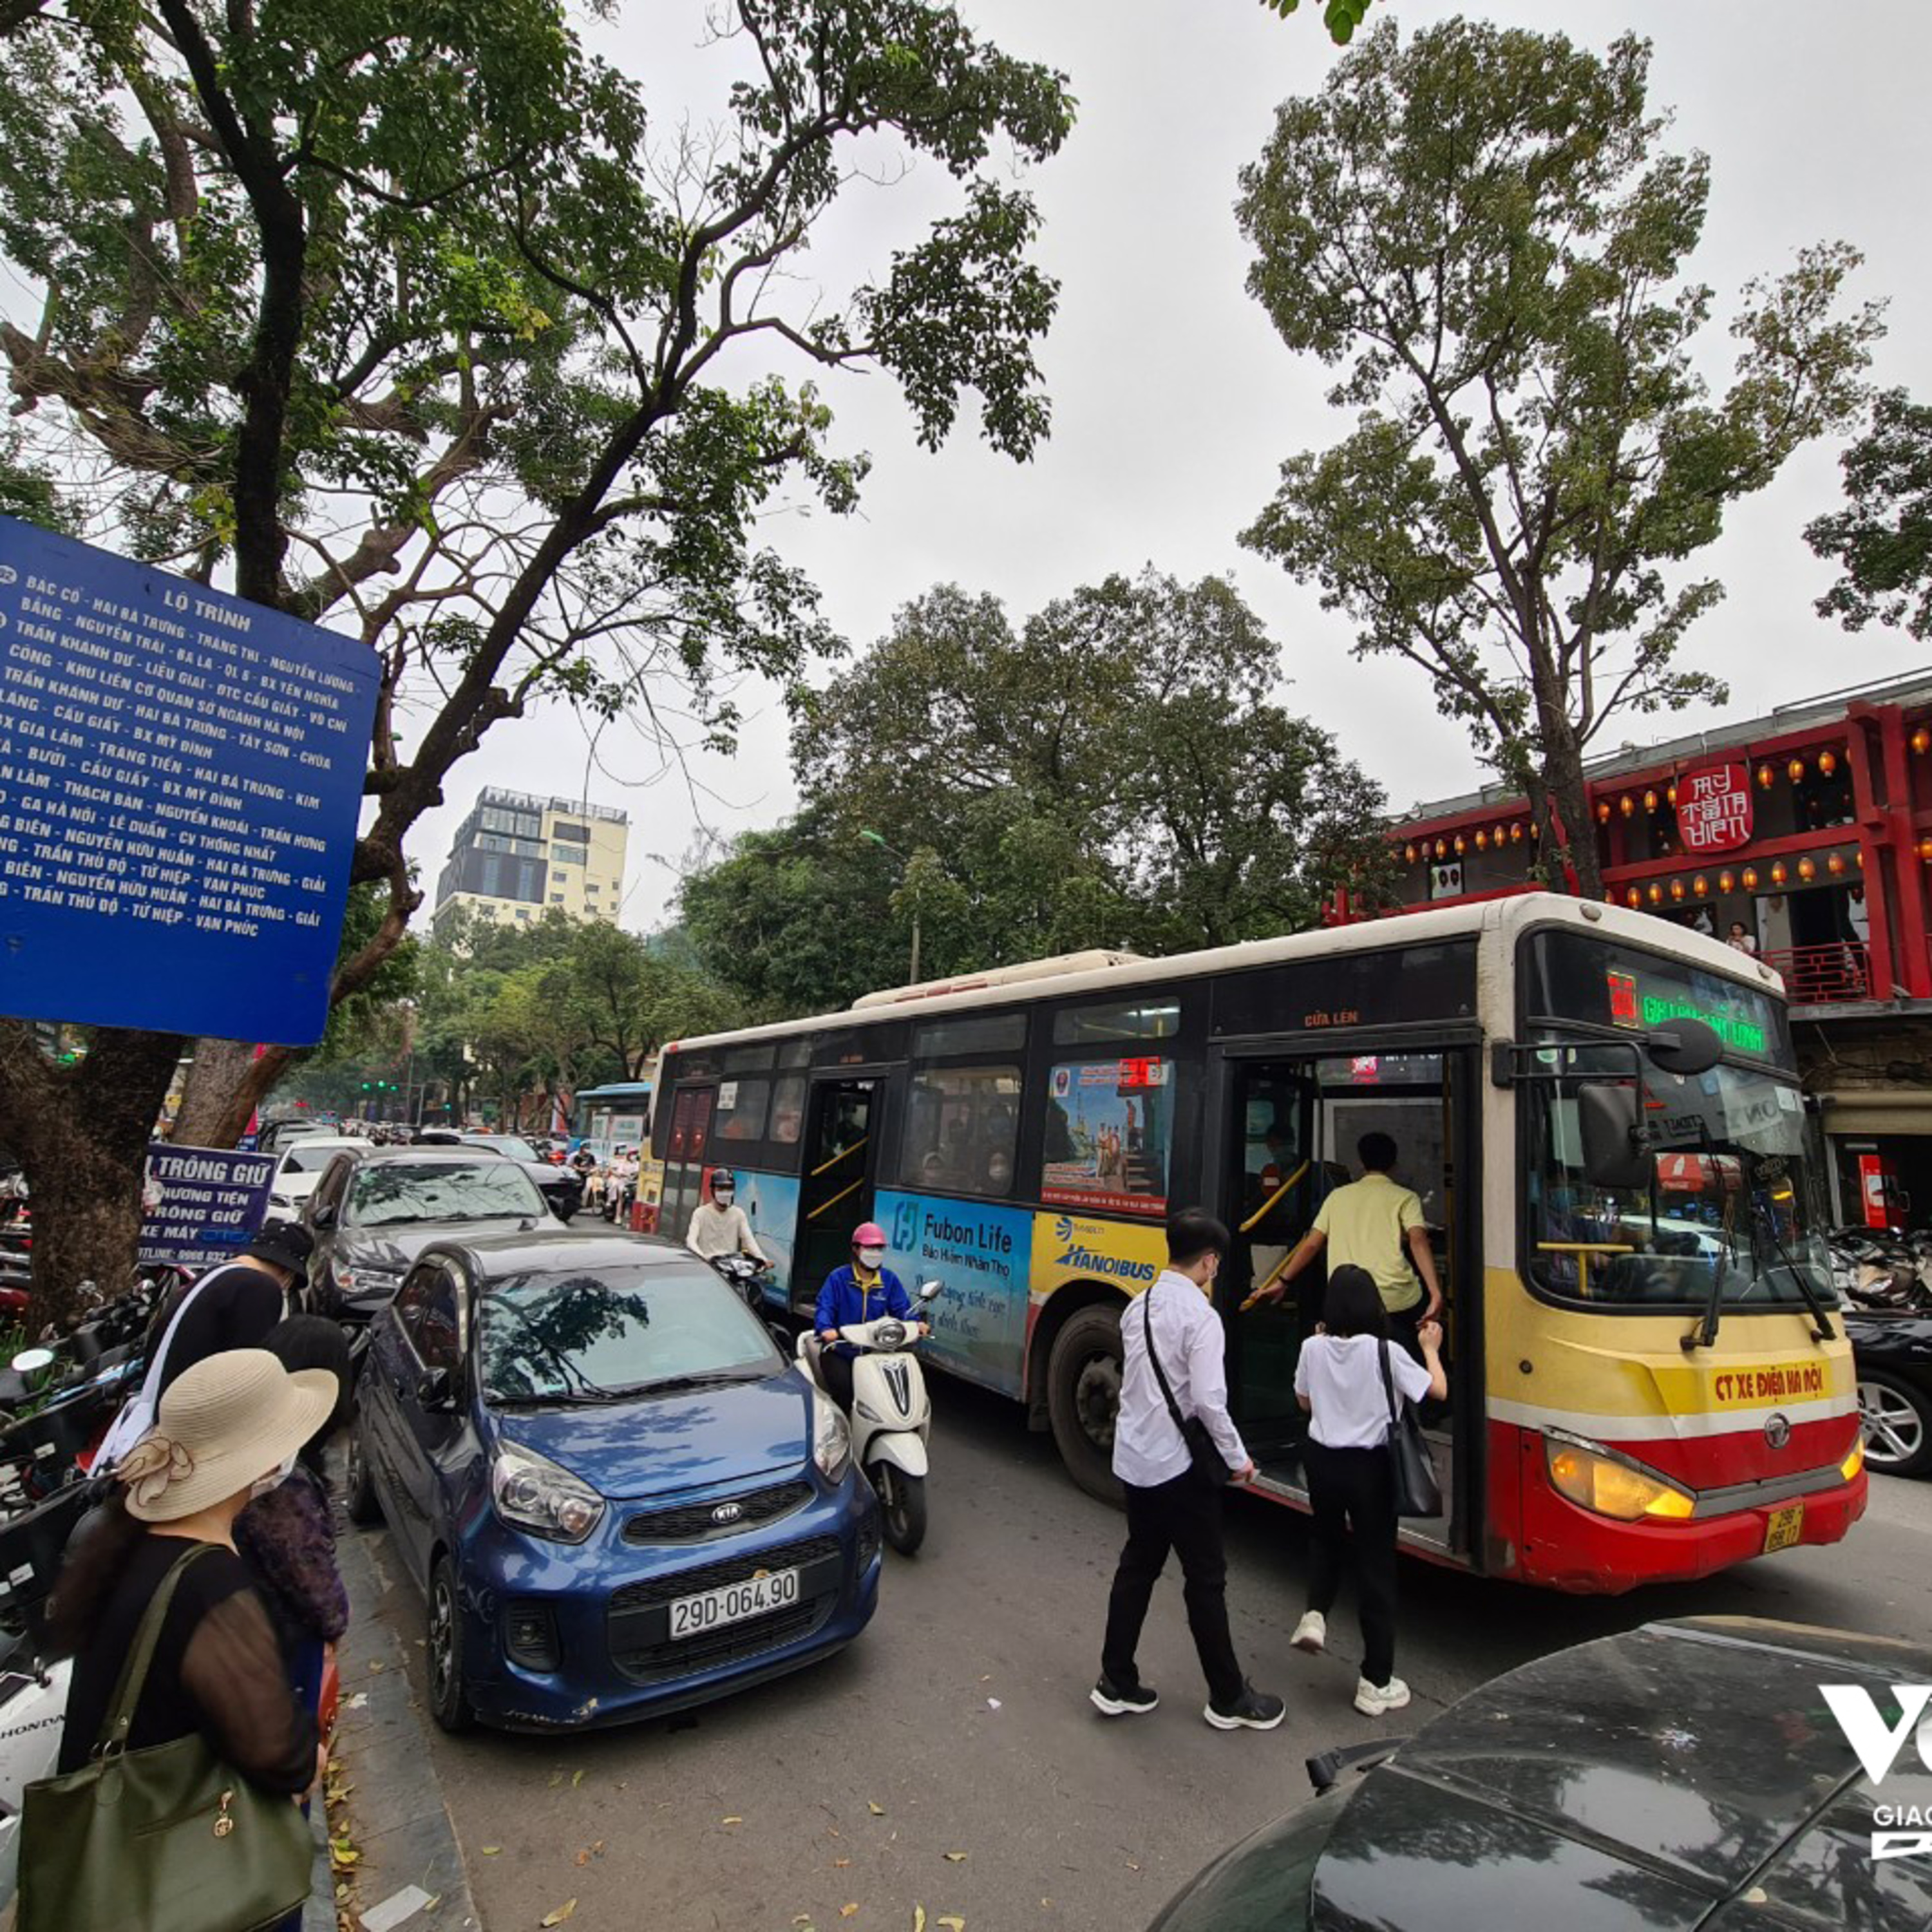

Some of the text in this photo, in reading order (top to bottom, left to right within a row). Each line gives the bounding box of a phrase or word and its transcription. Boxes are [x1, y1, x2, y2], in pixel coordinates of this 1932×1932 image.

[159, 1155, 228, 1182] TRÔNG
[232, 1163, 272, 1184] GIỮ
[161, 1187, 213, 1202] HƯƠNG
[155, 1206, 245, 1224] RÔNG GIỮ
[164, 1226, 198, 1239] MÁY
[924, 1213, 1012, 1253] Fubon Life
[1715, 1374, 1734, 1401] CT
[1736, 1372, 1754, 1399] XE
[714, 1506, 739, 1520] KIA
[0, 1714, 66, 1739] HONDA
